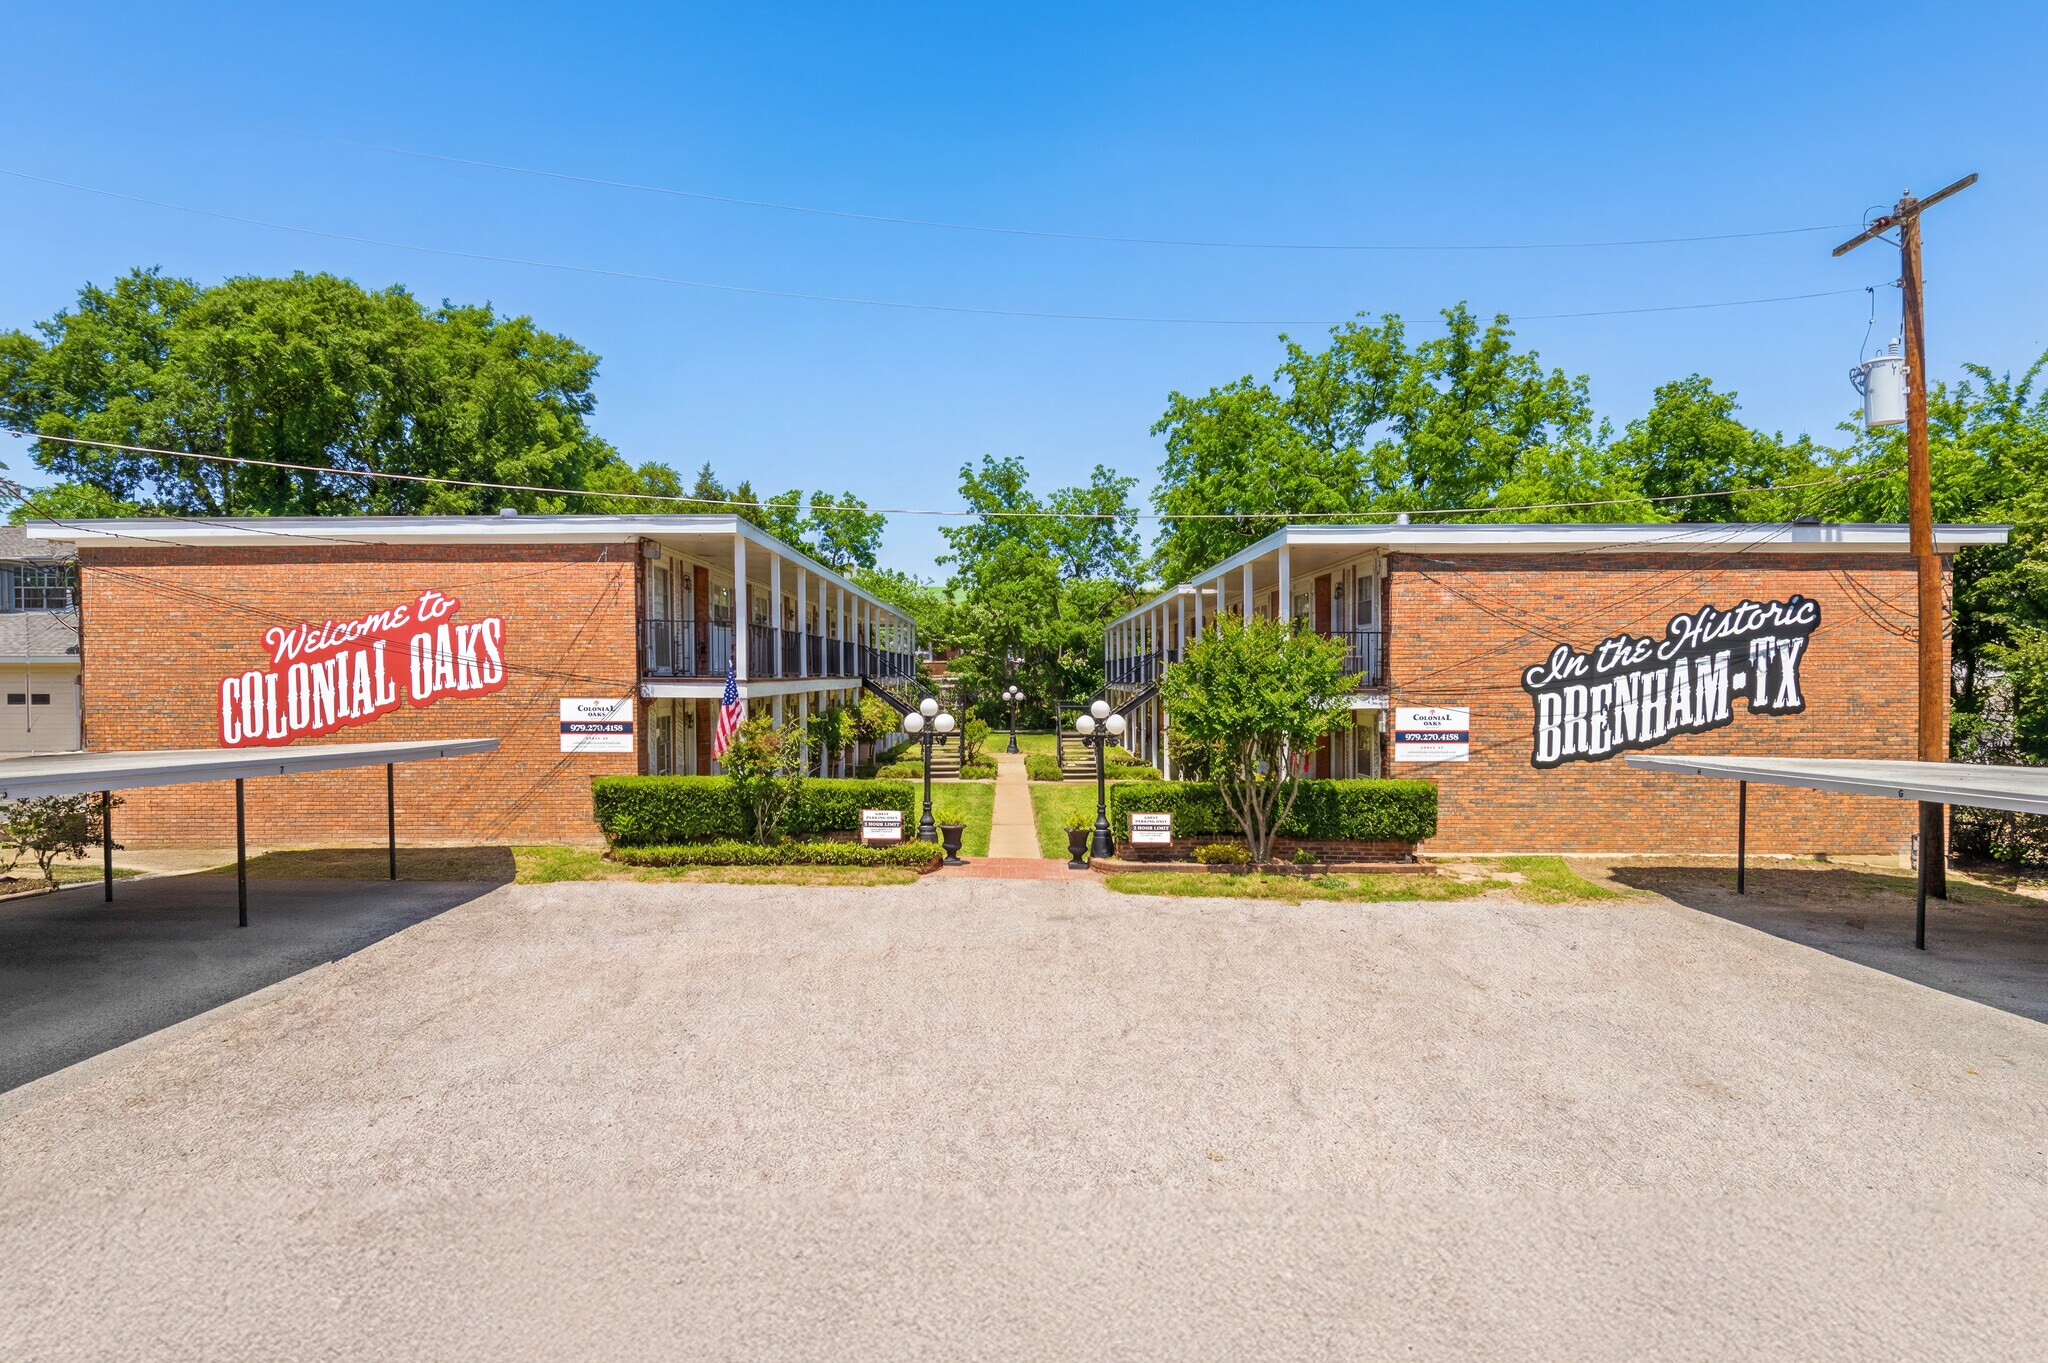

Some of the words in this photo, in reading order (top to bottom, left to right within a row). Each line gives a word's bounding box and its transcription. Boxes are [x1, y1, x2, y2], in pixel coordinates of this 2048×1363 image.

[265, 605, 410, 664] Welcome
[417, 590, 456, 622] to
[1526, 645, 1589, 688] In
[1596, 635, 1653, 673] the
[1656, 596, 1817, 660] Historic
[222, 639, 396, 745] COLONIAL
[409, 617, 503, 701] OAKS
[1535, 635, 1804, 763] BRENHAM-TX
[577, 704, 616, 712] COLONIAL
[1412, 713, 1452, 721] COLONIAL
[570, 724, 624, 732] 979.270.4158
[1405, 733, 1459, 741] 979.270.4158
[1898, 789, 1904, 798] G
